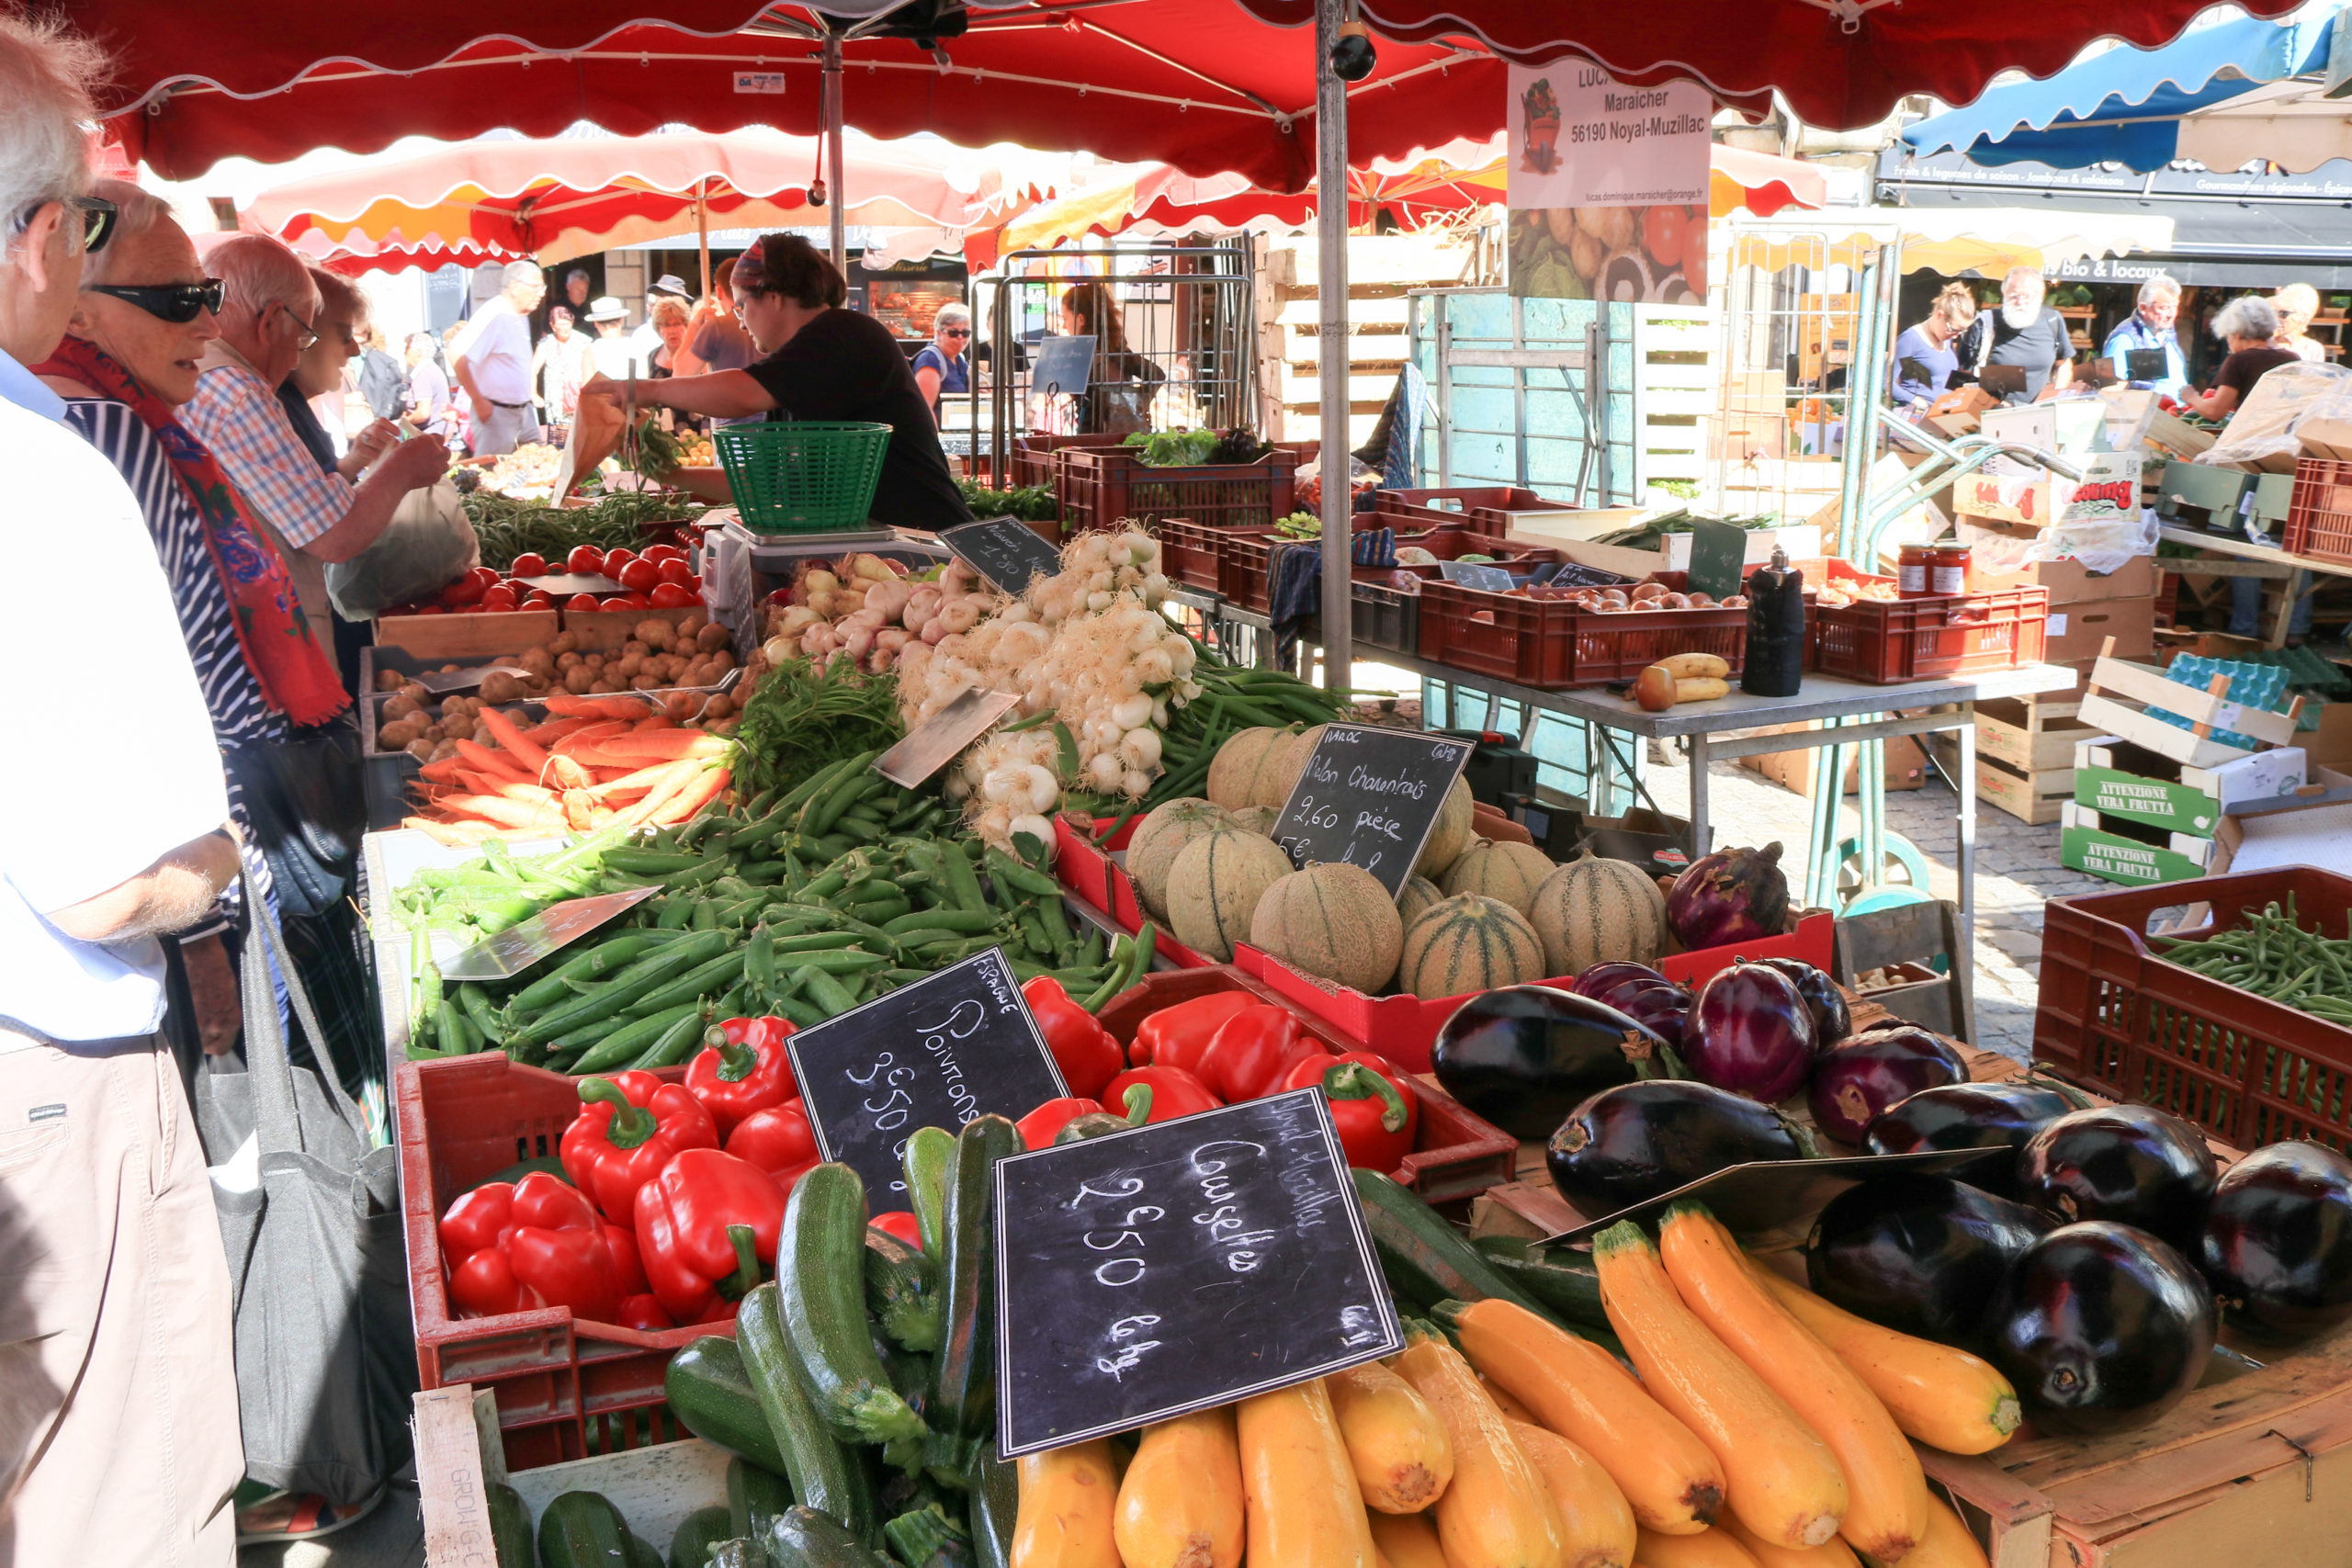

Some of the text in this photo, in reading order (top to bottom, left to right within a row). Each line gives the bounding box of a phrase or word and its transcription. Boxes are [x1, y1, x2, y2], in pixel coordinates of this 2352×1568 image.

[1604, 90, 1668, 113] Maraicher
[1571, 114, 1705, 143] 56190 Noyal-Muzillac
[1922, 168, 1930, 177] &
[1974, 170, 1986, 180] de
[1989, 172, 2019, 183] saison
[2027, 172, 2069, 185] Jambons
[2070, 174, 2079, 185] &
[2081, 175, 2124, 186] salaisons
[2196, 179, 2265, 193] Gourmandises
[1586, 187, 1703, 203] lucas.dominique.maraicher@orange.fr
[2062, 261, 2089, 276] bio
[2093, 261, 2108, 277] &
[2112, 262, 2167, 279] locaux
[2100, 783, 2166, 800] ATTENZIONE
[2096, 795, 2175, 815] VERA FRUTTA
[1293, 795, 1404, 842] 2,60 pièce
[2088, 843, 2154, 864] ATTENZIONE
[2083, 855, 2161, 880] VERA FRUTTA
[974, 957, 1018, 1014] ESPAGNE
[917, 999, 985, 1124] Poivrons
[845, 1052, 916, 1131] 3€50
[1190, 1139, 1276, 1273] Courgettes
[1071, 1178, 1165, 1287] 2€50
